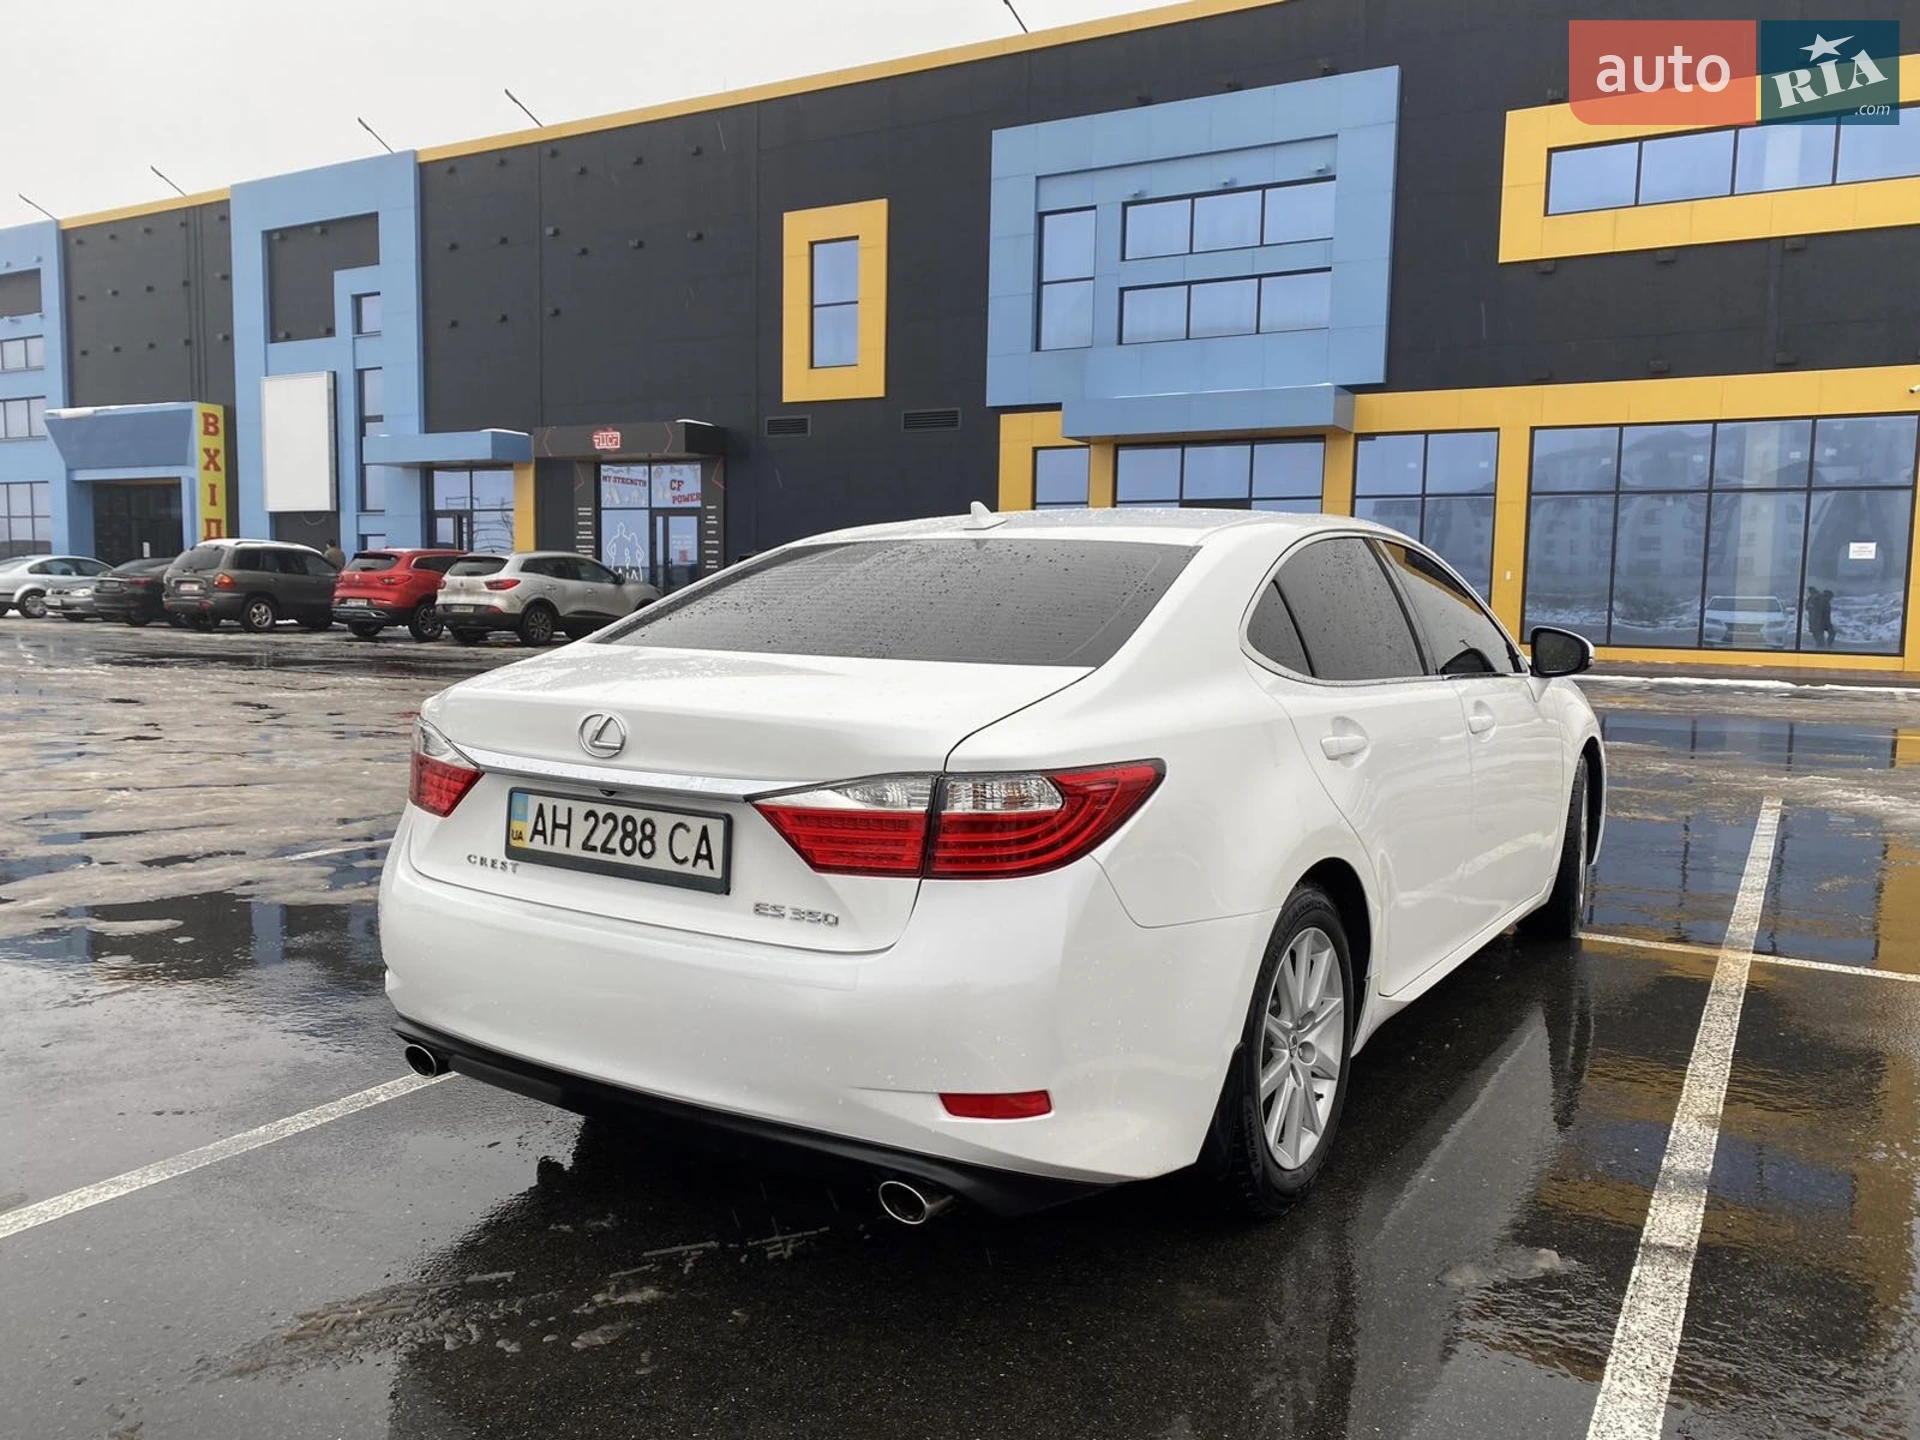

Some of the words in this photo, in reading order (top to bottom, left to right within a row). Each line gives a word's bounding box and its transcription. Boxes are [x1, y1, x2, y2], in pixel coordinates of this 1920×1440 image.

[670, 479, 684, 491] CF
[672, 492, 702, 505] POWER
[511, 828, 524, 842] UA
[529, 802, 572, 848] AH
[581, 809, 656, 860] 2288
[668, 821, 715, 871] CA
[466, 854, 520, 874] CREST
[754, 902, 786, 919] ES
[789, 906, 840, 928] 350
